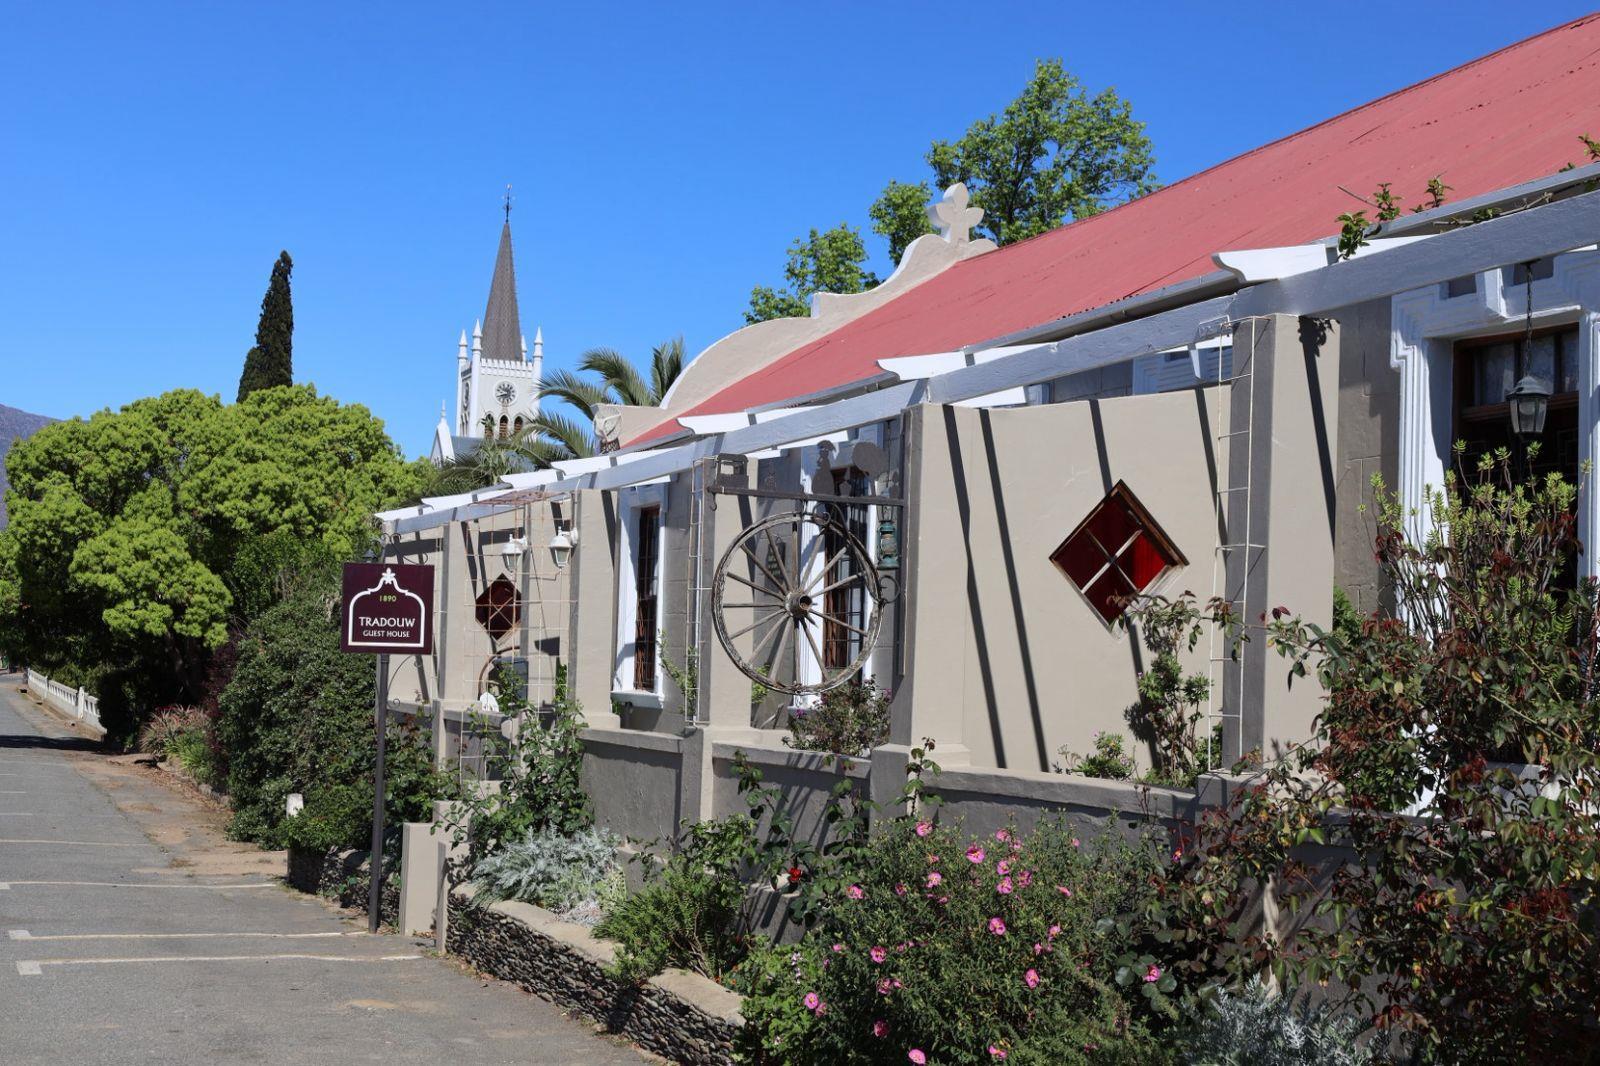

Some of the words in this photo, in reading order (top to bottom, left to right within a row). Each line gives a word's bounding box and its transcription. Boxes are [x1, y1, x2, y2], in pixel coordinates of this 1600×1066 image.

[358, 616, 416, 628] TRADOUW
[362, 630, 385, 638] GUEST
[386, 630, 410, 638] HOUSE
